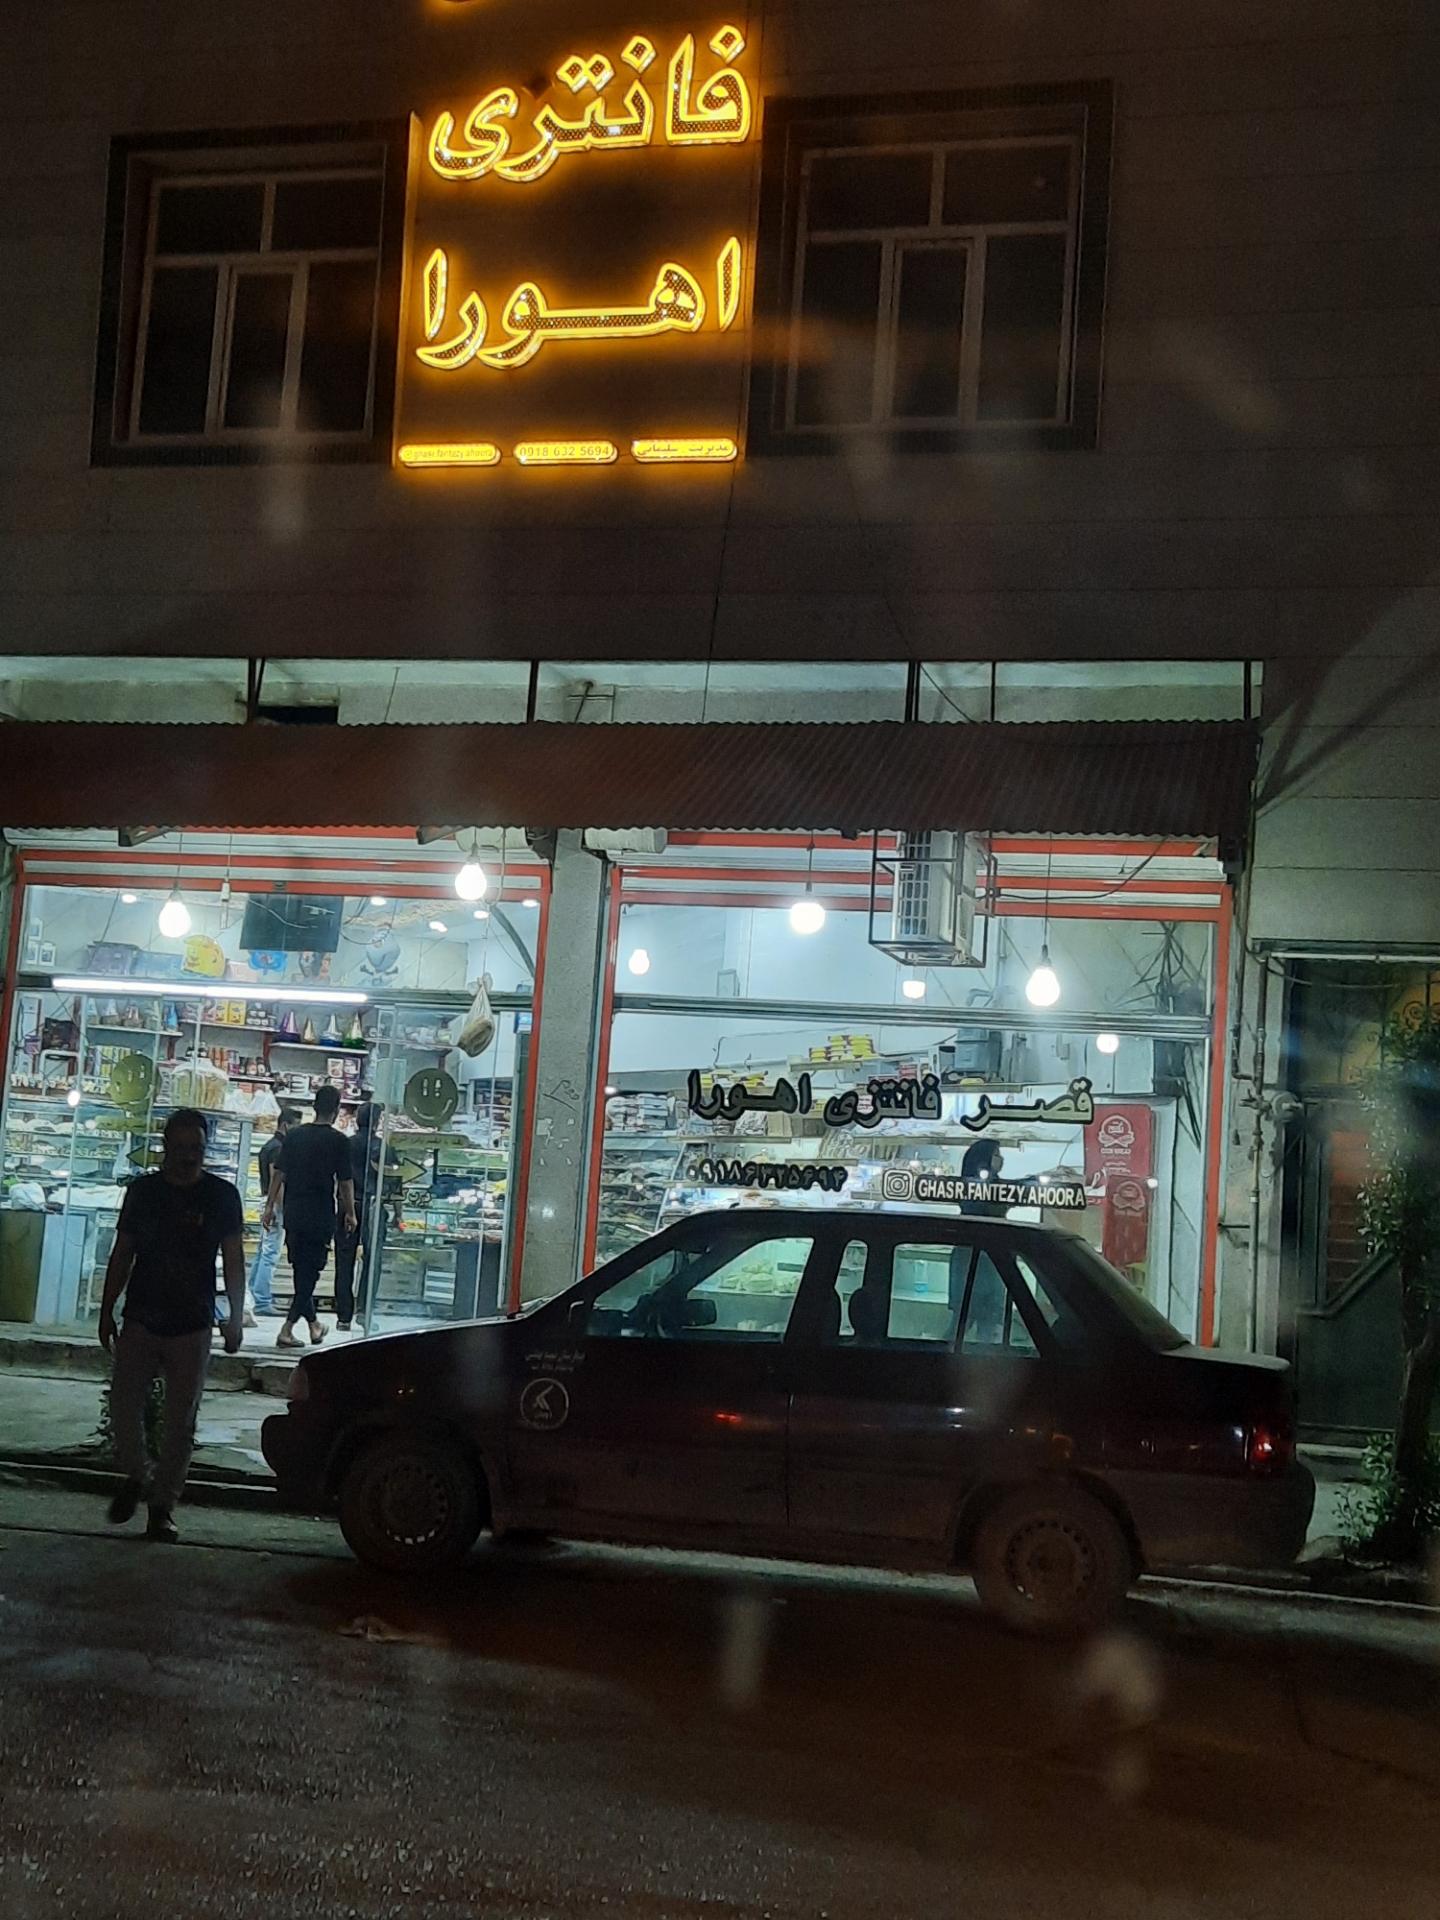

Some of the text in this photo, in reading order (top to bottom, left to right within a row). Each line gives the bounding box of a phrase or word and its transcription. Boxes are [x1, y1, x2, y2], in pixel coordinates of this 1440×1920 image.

[416, 236, 741, 370] اهورا
[519, 446, 610, 457] 0918 632 5694
[688, 1069, 1095, 1131] قصر فانتزی اهورا
[917, 1179, 1085, 1206] GHASR.FANTEZY.AHOORA
